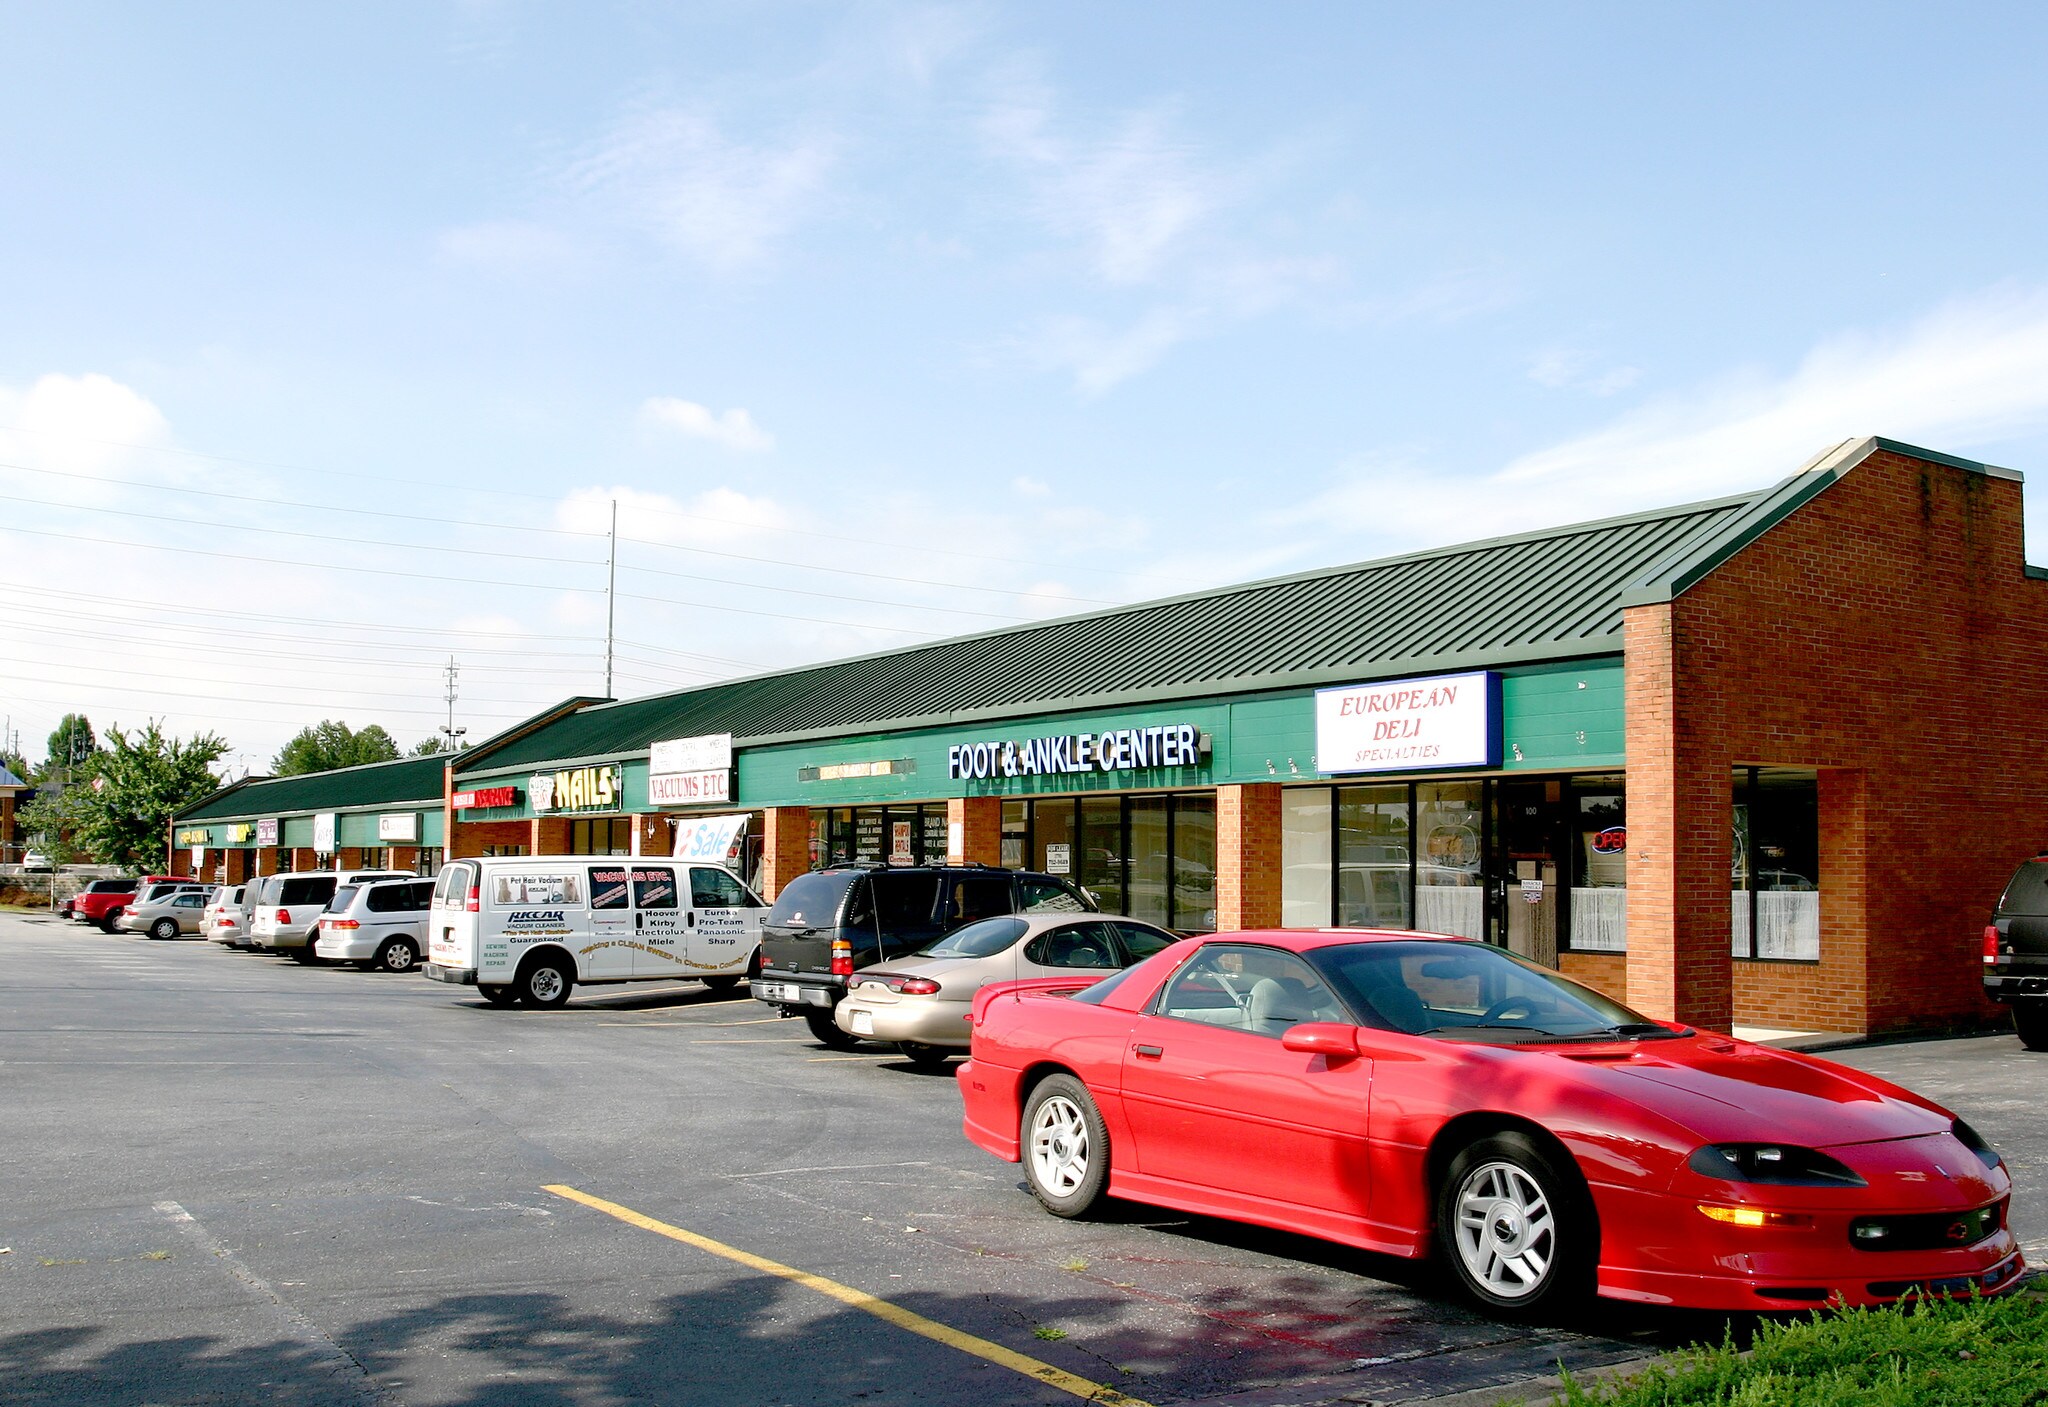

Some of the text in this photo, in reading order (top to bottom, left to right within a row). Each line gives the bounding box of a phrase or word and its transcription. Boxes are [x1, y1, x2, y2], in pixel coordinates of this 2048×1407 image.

[1339, 685, 1458, 717] EUROPEAN
[1372, 718, 1422, 742] DELI
[948, 723, 1199, 780] FOOT & ANKLE CENTER
[1354, 744, 1441, 763] SPECIALTIES
[556, 767, 613, 811] NAILS
[651, 773, 728, 799] VACUUMS ETC.
[1525, 806, 1537, 816] 100
[690, 823, 729, 857] Sale
[649, 920, 676, 928] Kirby
[708, 938, 736, 946] Sharp
